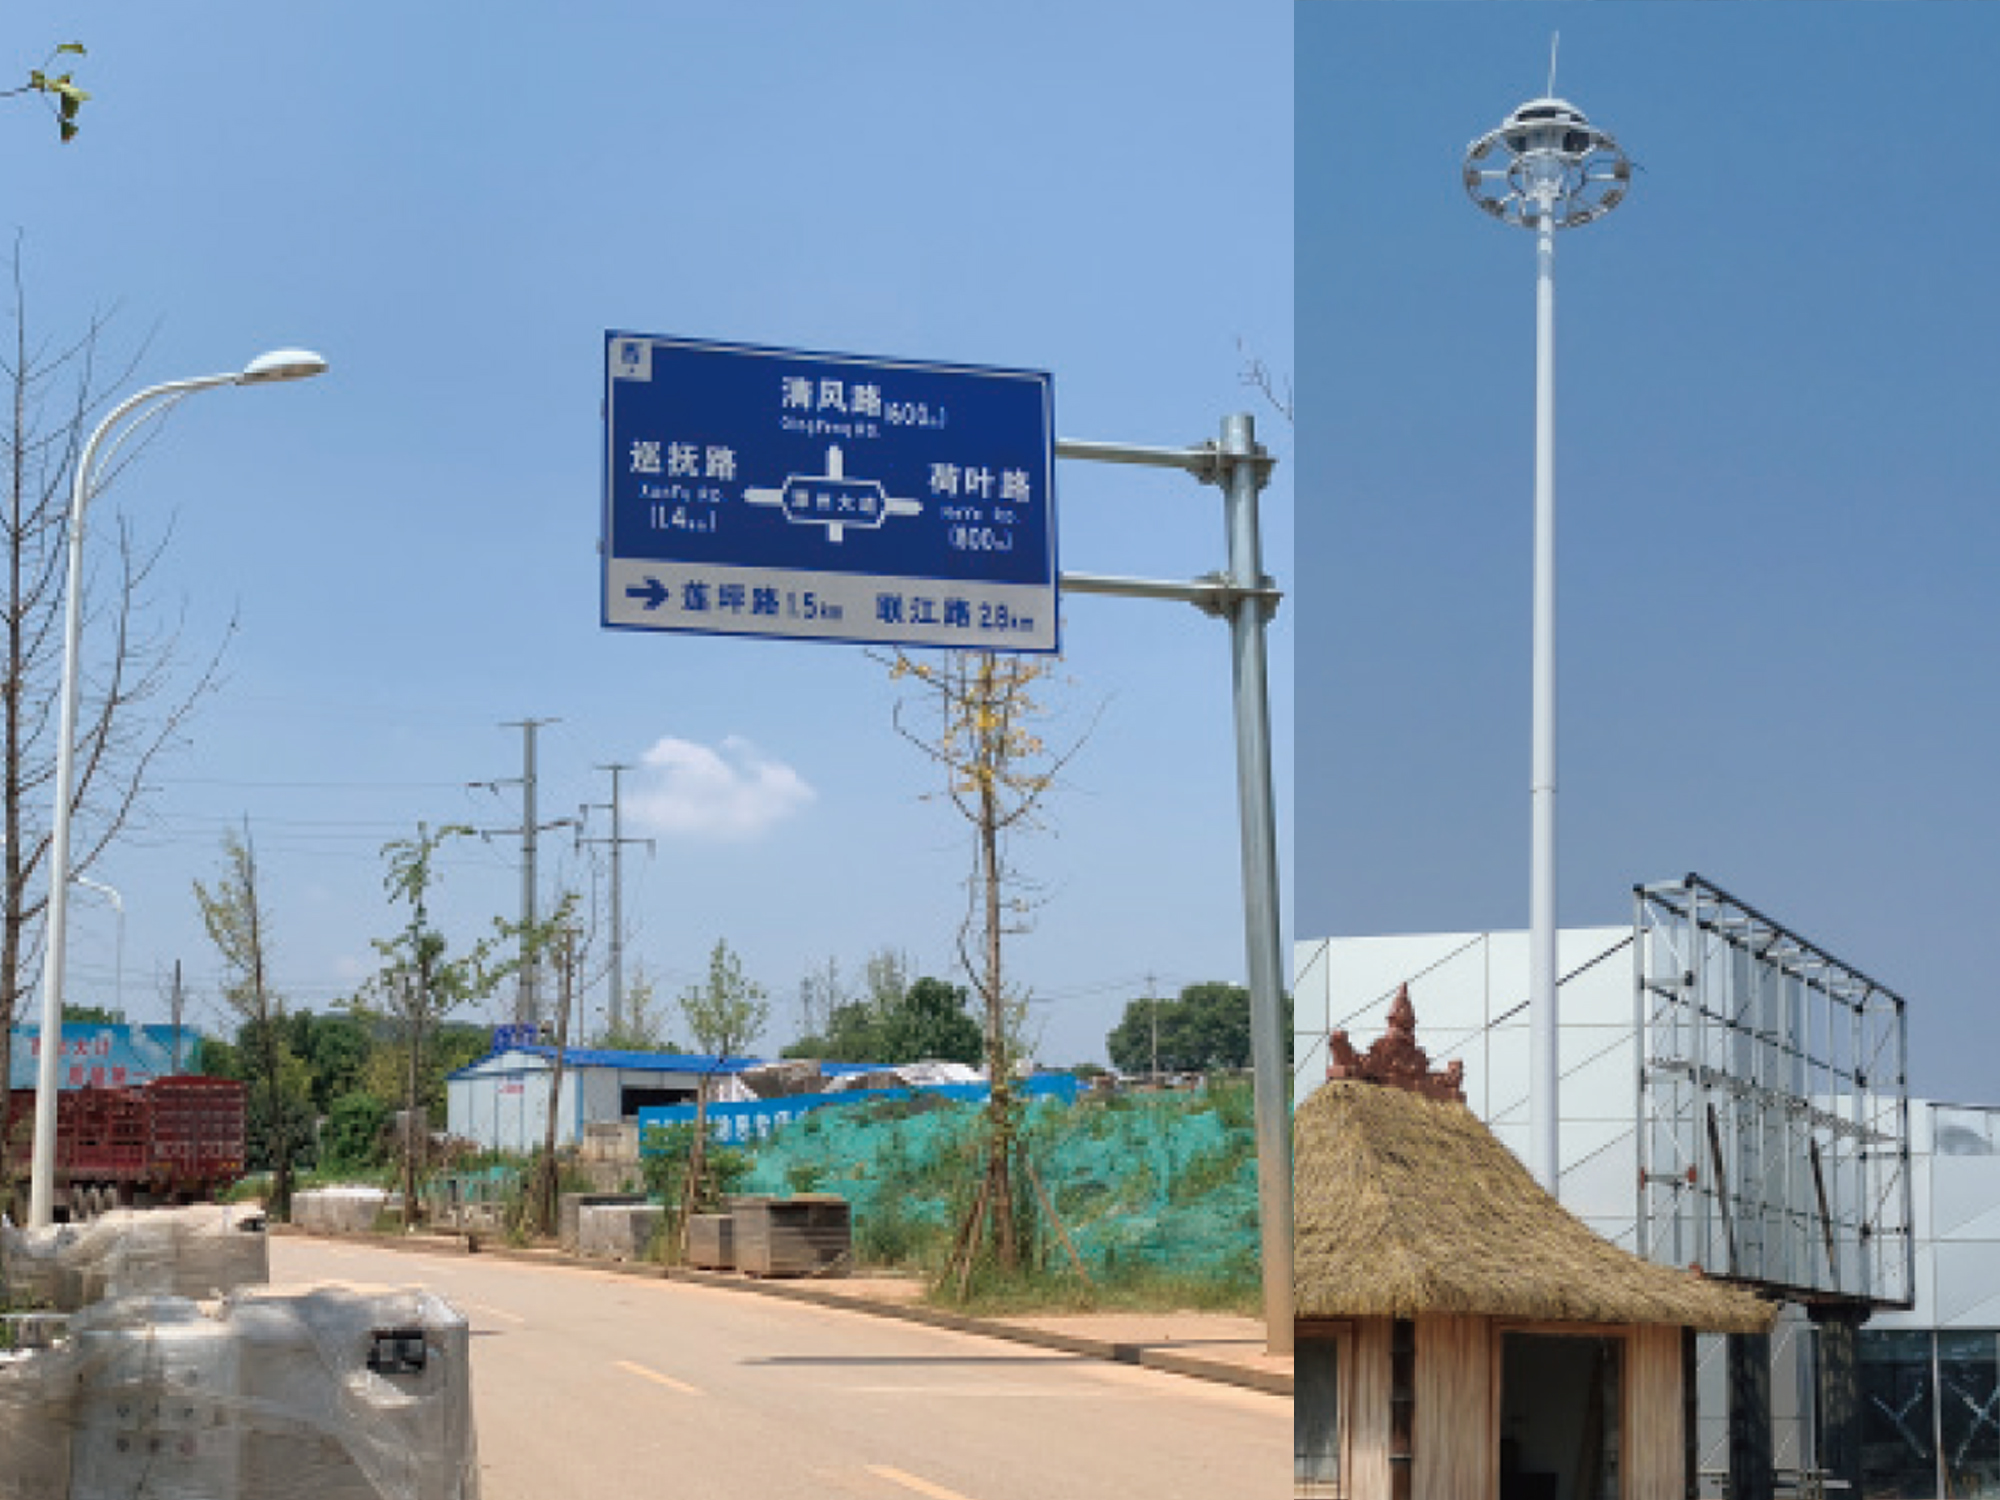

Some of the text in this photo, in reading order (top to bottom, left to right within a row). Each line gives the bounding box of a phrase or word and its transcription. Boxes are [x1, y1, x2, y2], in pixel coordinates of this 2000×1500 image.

[781, 376, 882, 417] 清风路
[629, 441, 737, 481] 巡抚路
[927, 463, 1031, 502] 荷叶路
[681, 580, 779, 615] 莲坪路
[876, 592, 970, 628] 联江路
